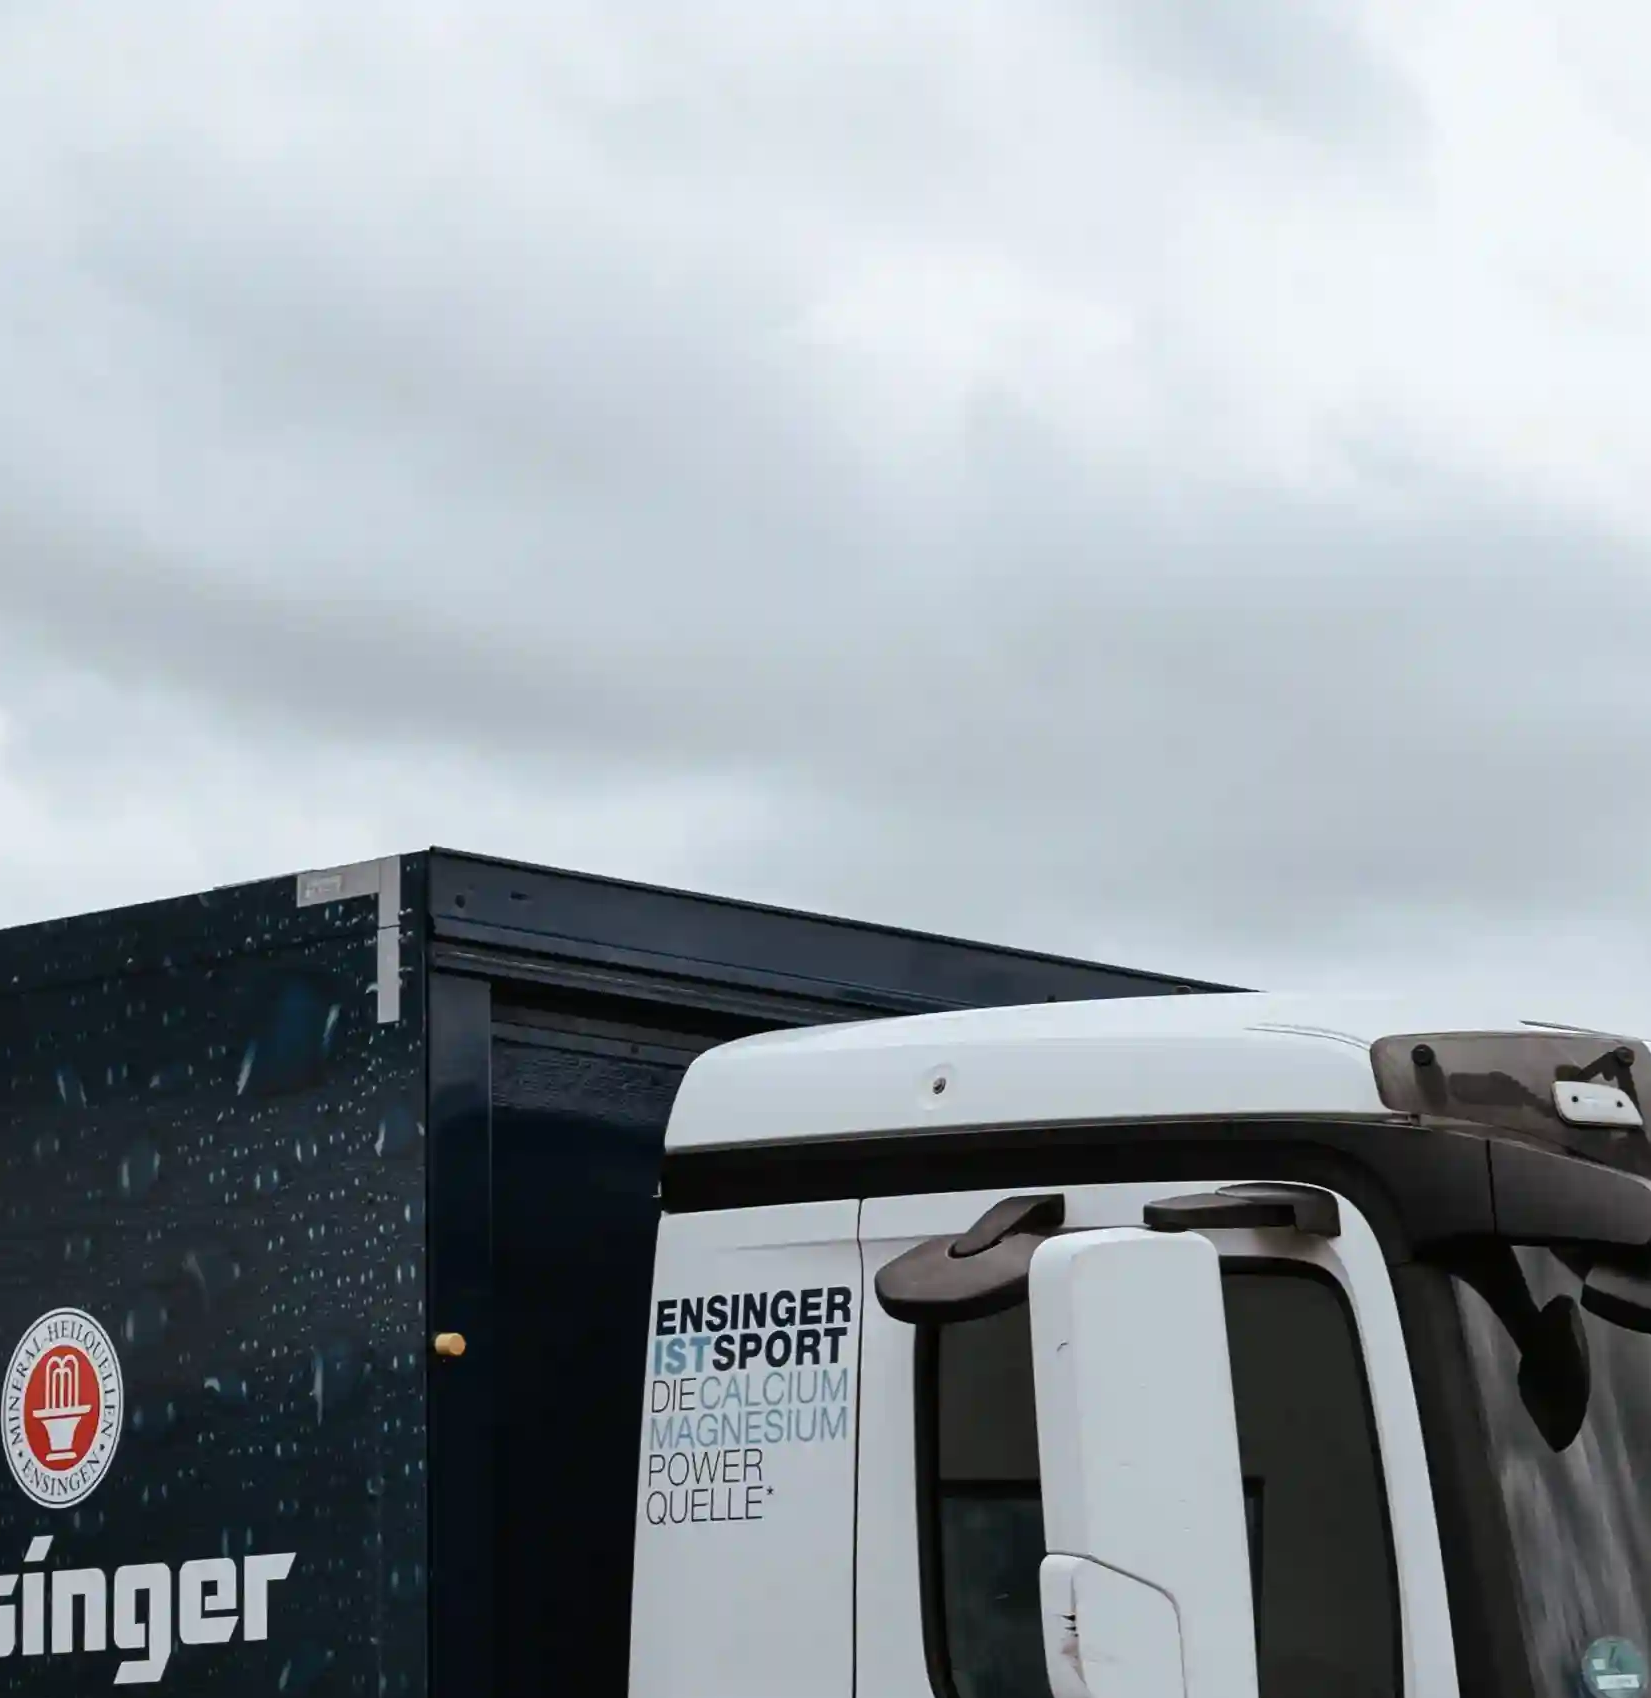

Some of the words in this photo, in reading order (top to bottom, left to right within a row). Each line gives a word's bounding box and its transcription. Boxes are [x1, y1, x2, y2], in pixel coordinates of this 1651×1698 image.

[656, 1286, 852, 1336] ENSINGER
[649, 1406, 847, 1450] MAGNESIUM
[21, 1452, 100, 1496] ENSINGEN
[648, 1448, 763, 1487] POWER
